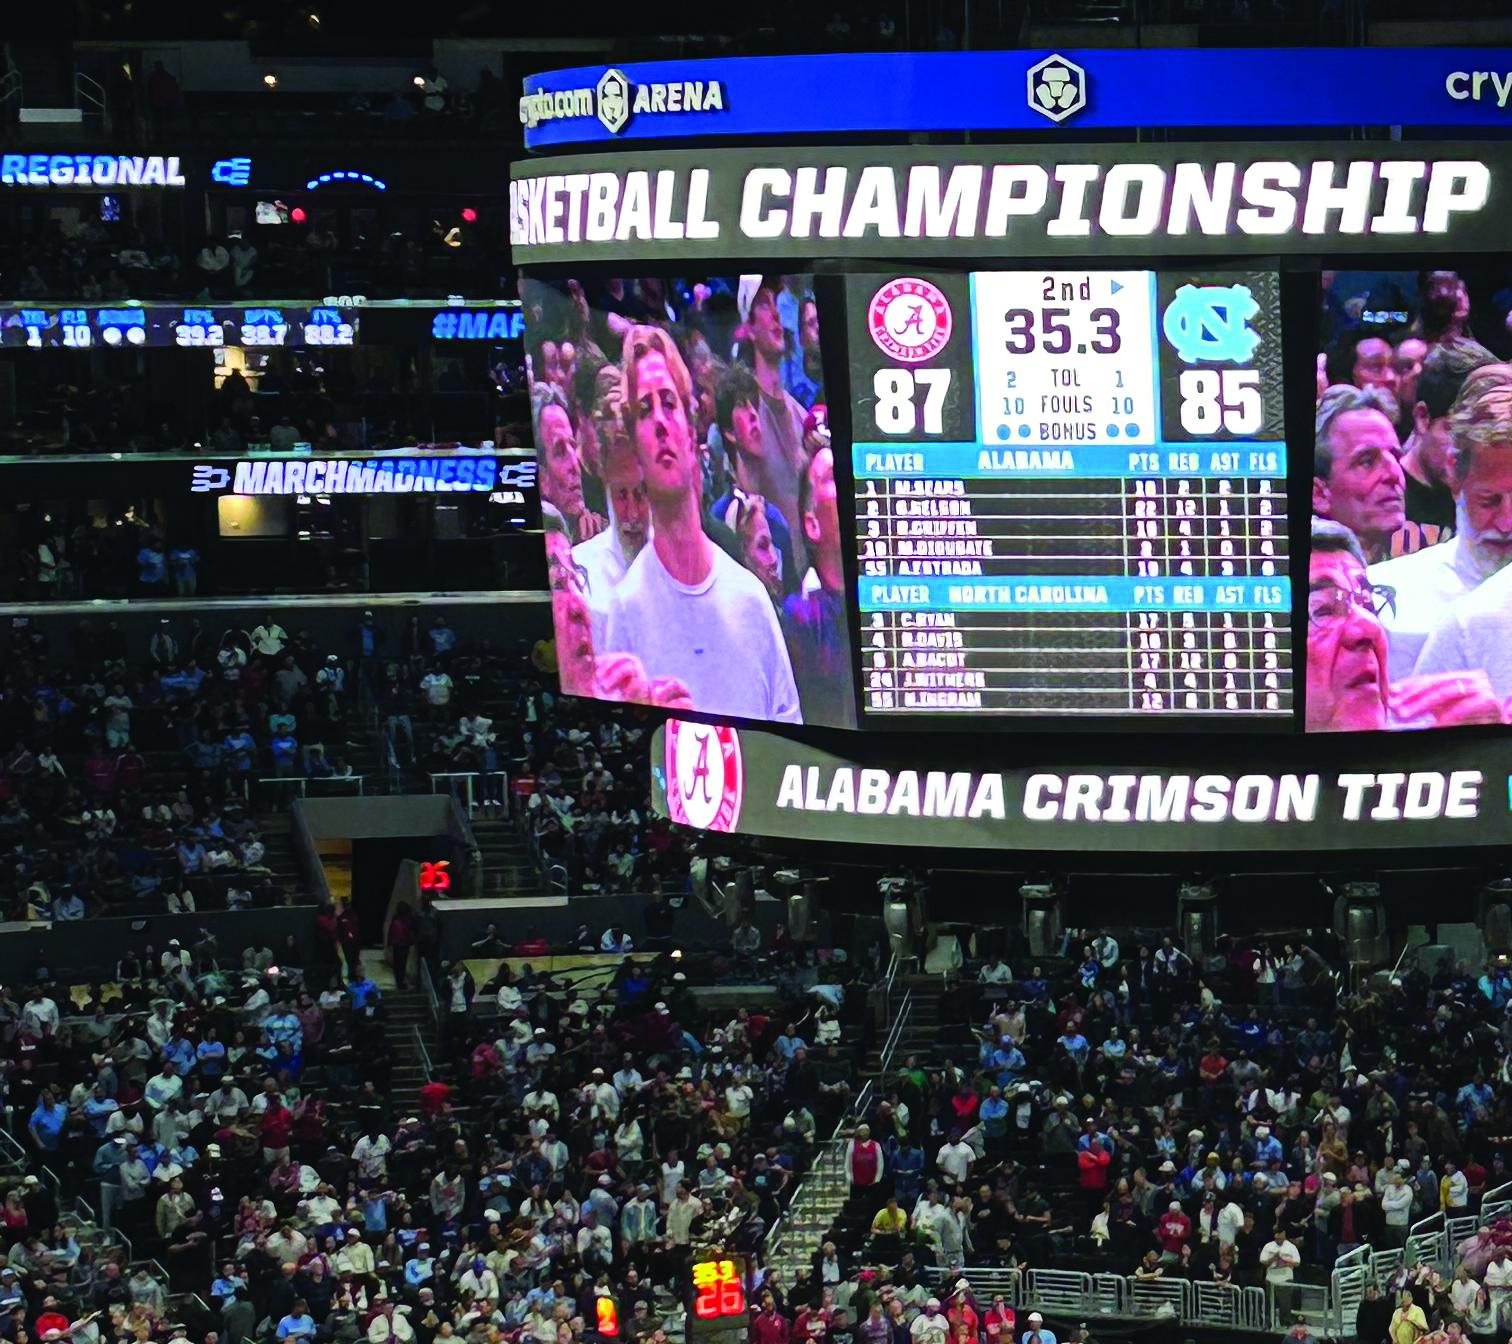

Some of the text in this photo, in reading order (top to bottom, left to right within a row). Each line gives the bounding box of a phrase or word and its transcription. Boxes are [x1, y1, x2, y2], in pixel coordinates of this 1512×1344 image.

[633, 80, 723, 113] ARENA
[1, 154, 185, 186] REGIONAL
[739, 160, 1491, 239] CHAMPIONSHIP
[1043, 276, 1091, 301] 2nd
[63, 325, 90, 347] 10
[1005, 308, 1122, 355] 35.3
[1007, 369, 1124, 388] 2 TOL 1
[874, 368, 951, 434] 87
[1003, 396, 1134, 415] 10 FOULS 10
[1179, 369, 1262, 434] 85
[1040, 423, 1097, 440] BONUS
[233, 458, 498, 494] MARCHMADNESS
[866, 451, 1277, 471] PLAYER ALABAMA PTS REB AST FLS
[871, 585, 1281, 604] PLAYER NORTH CAROLINA PTS REB AST FLS
[777, 764, 1006, 821] ALABAMA
[1021, 772, 1320, 823] CRIMSON
[1338, 770, 1483, 821] TIDE
